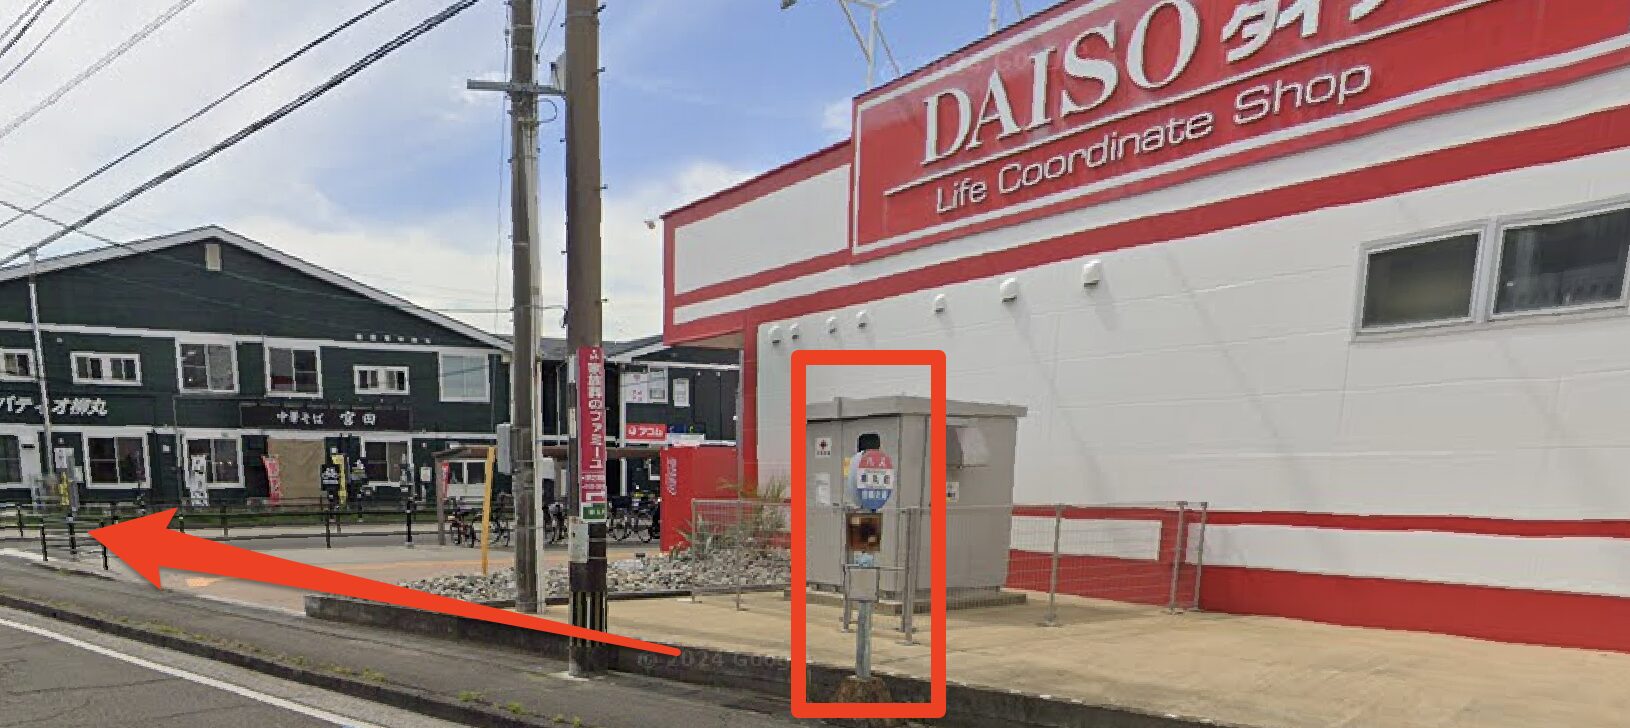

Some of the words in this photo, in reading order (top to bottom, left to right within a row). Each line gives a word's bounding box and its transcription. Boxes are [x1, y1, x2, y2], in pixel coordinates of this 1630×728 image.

[922, 0, 1200, 164] DAISO
[936, 177, 986, 214] Life
[998, 112, 1213, 193] Coordinate
[1233, 64, 1372, 125] Shop
